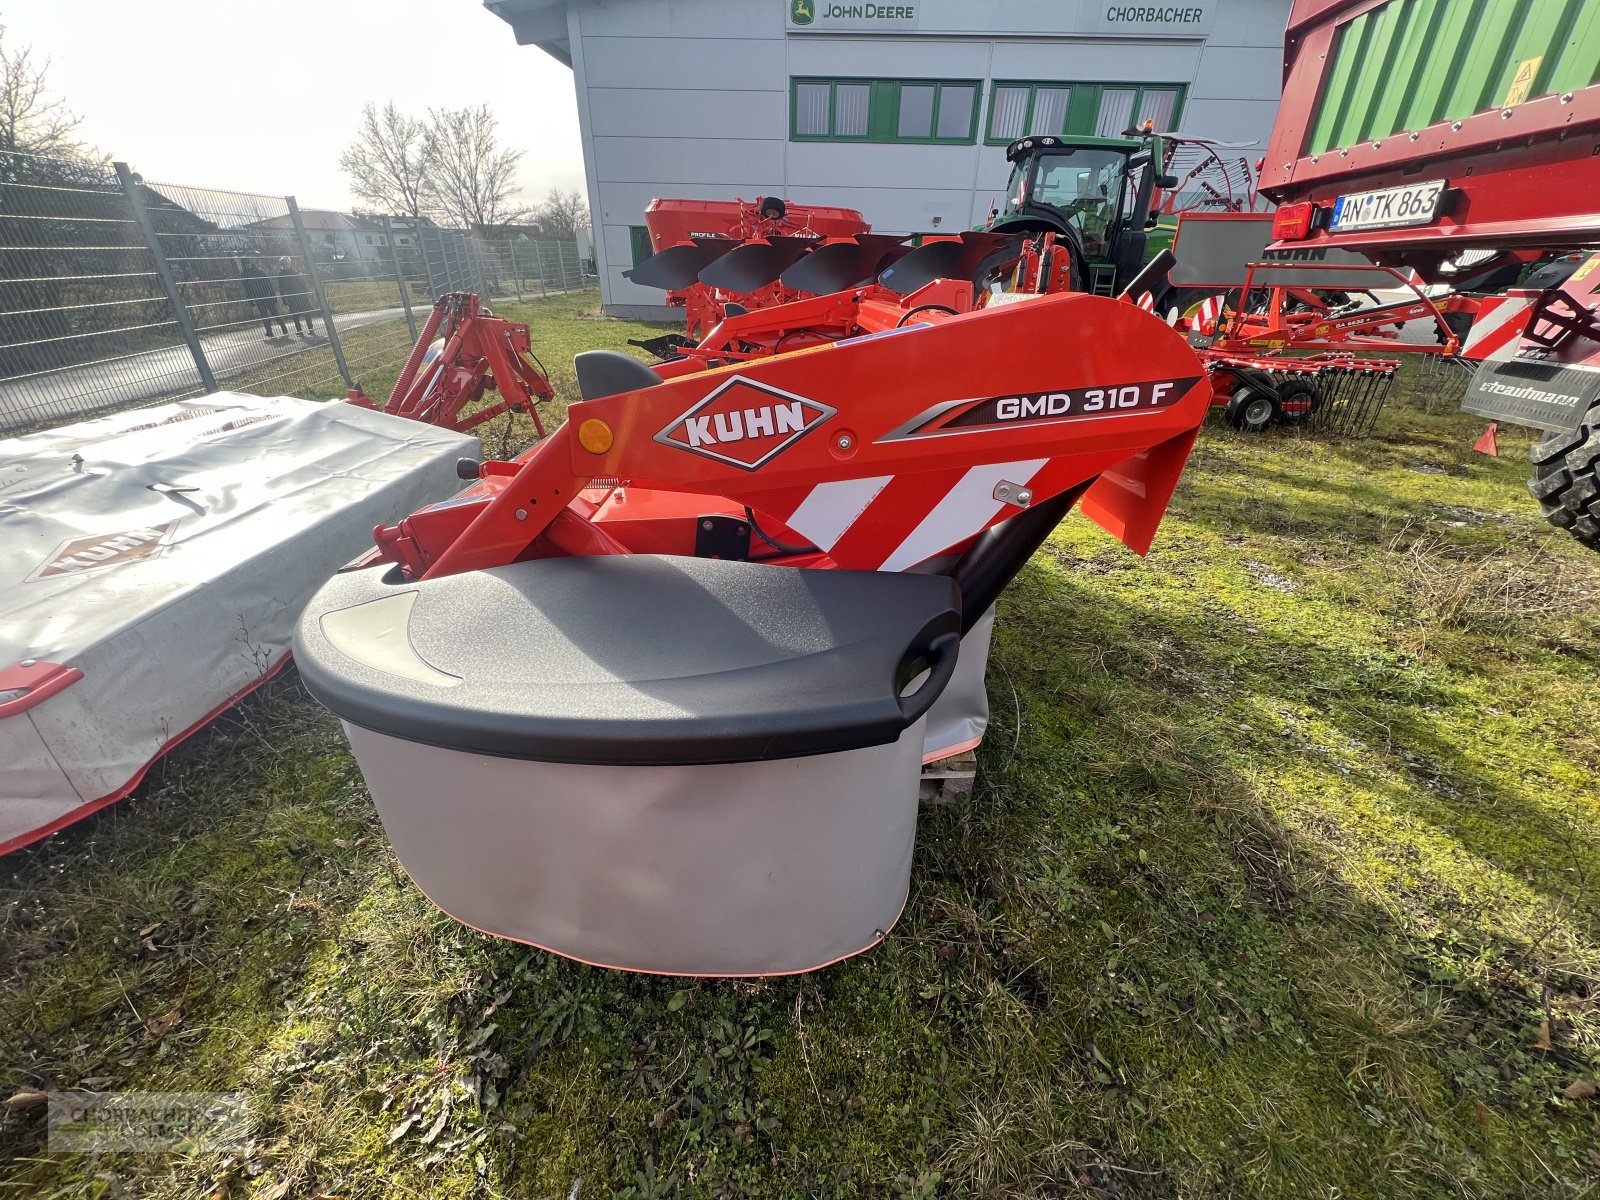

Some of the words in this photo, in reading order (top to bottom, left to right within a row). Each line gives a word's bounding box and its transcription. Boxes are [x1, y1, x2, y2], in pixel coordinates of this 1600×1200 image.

[823, 3, 863, 18] JOHN
[865, 3, 915, 19] DEERE
[1106, 6, 1203, 23] CHORBACHER
[1340, 198, 1365, 223] AN
[1373, 192, 1398, 219] TK
[1398, 187, 1440, 217] 863
[996, 393, 1071, 420] GMD
[1083, 386, 1140, 411] 310
[1151, 382, 1174, 405] F
[684, 401, 805, 447] KUHN
[48, 528, 167, 572] KUHN
